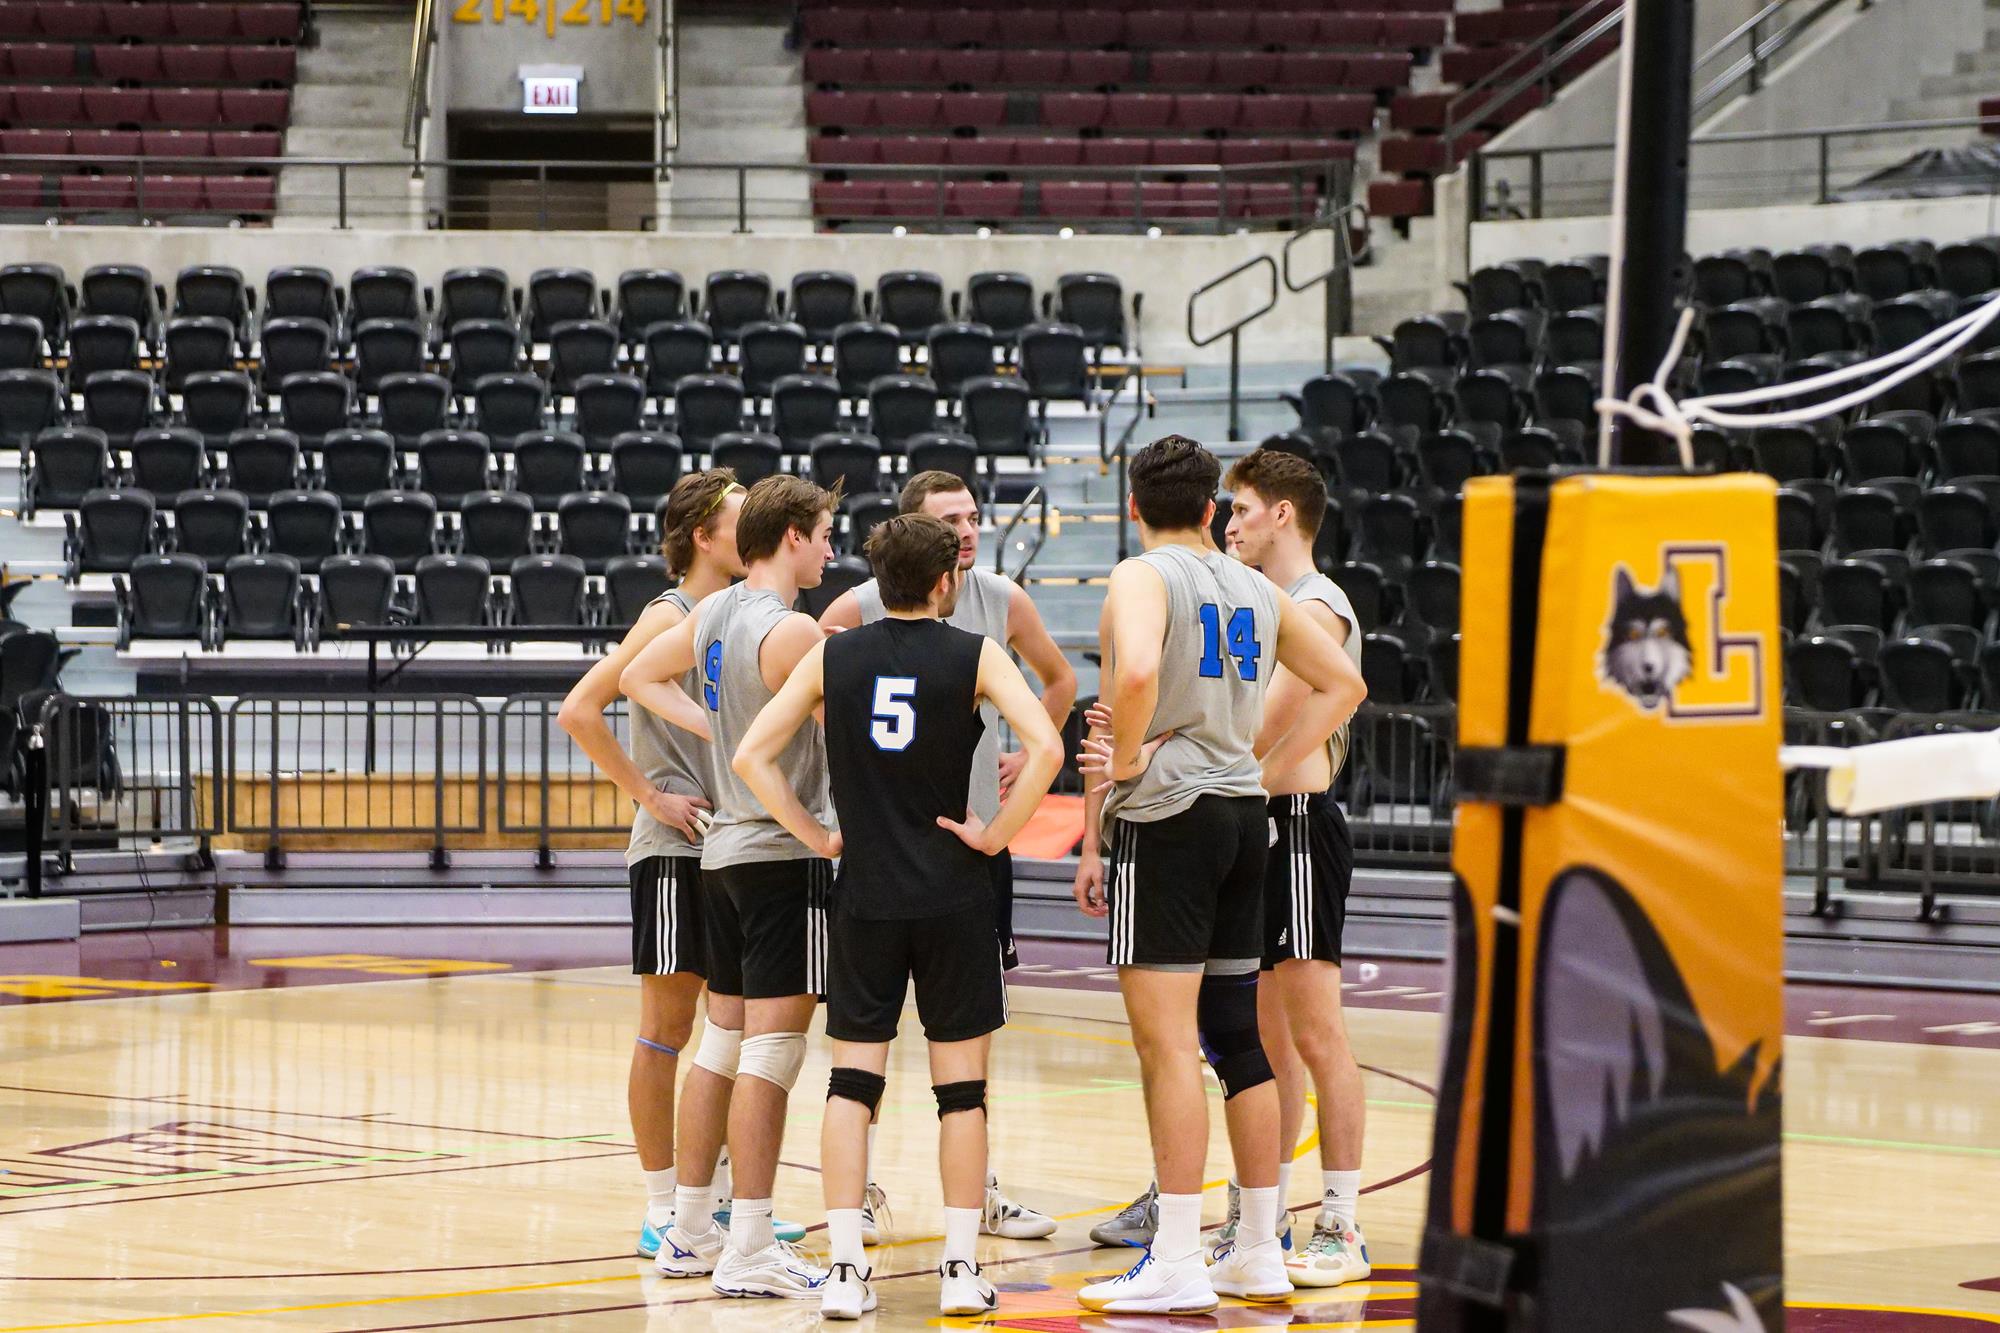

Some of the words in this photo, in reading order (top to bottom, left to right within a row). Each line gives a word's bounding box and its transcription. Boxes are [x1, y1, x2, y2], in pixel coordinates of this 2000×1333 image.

[533, 85, 570, 106] EXIT
[704, 639, 722, 712] 9
[1199, 603, 1261, 682] 14
[870, 675, 917, 752] 5
